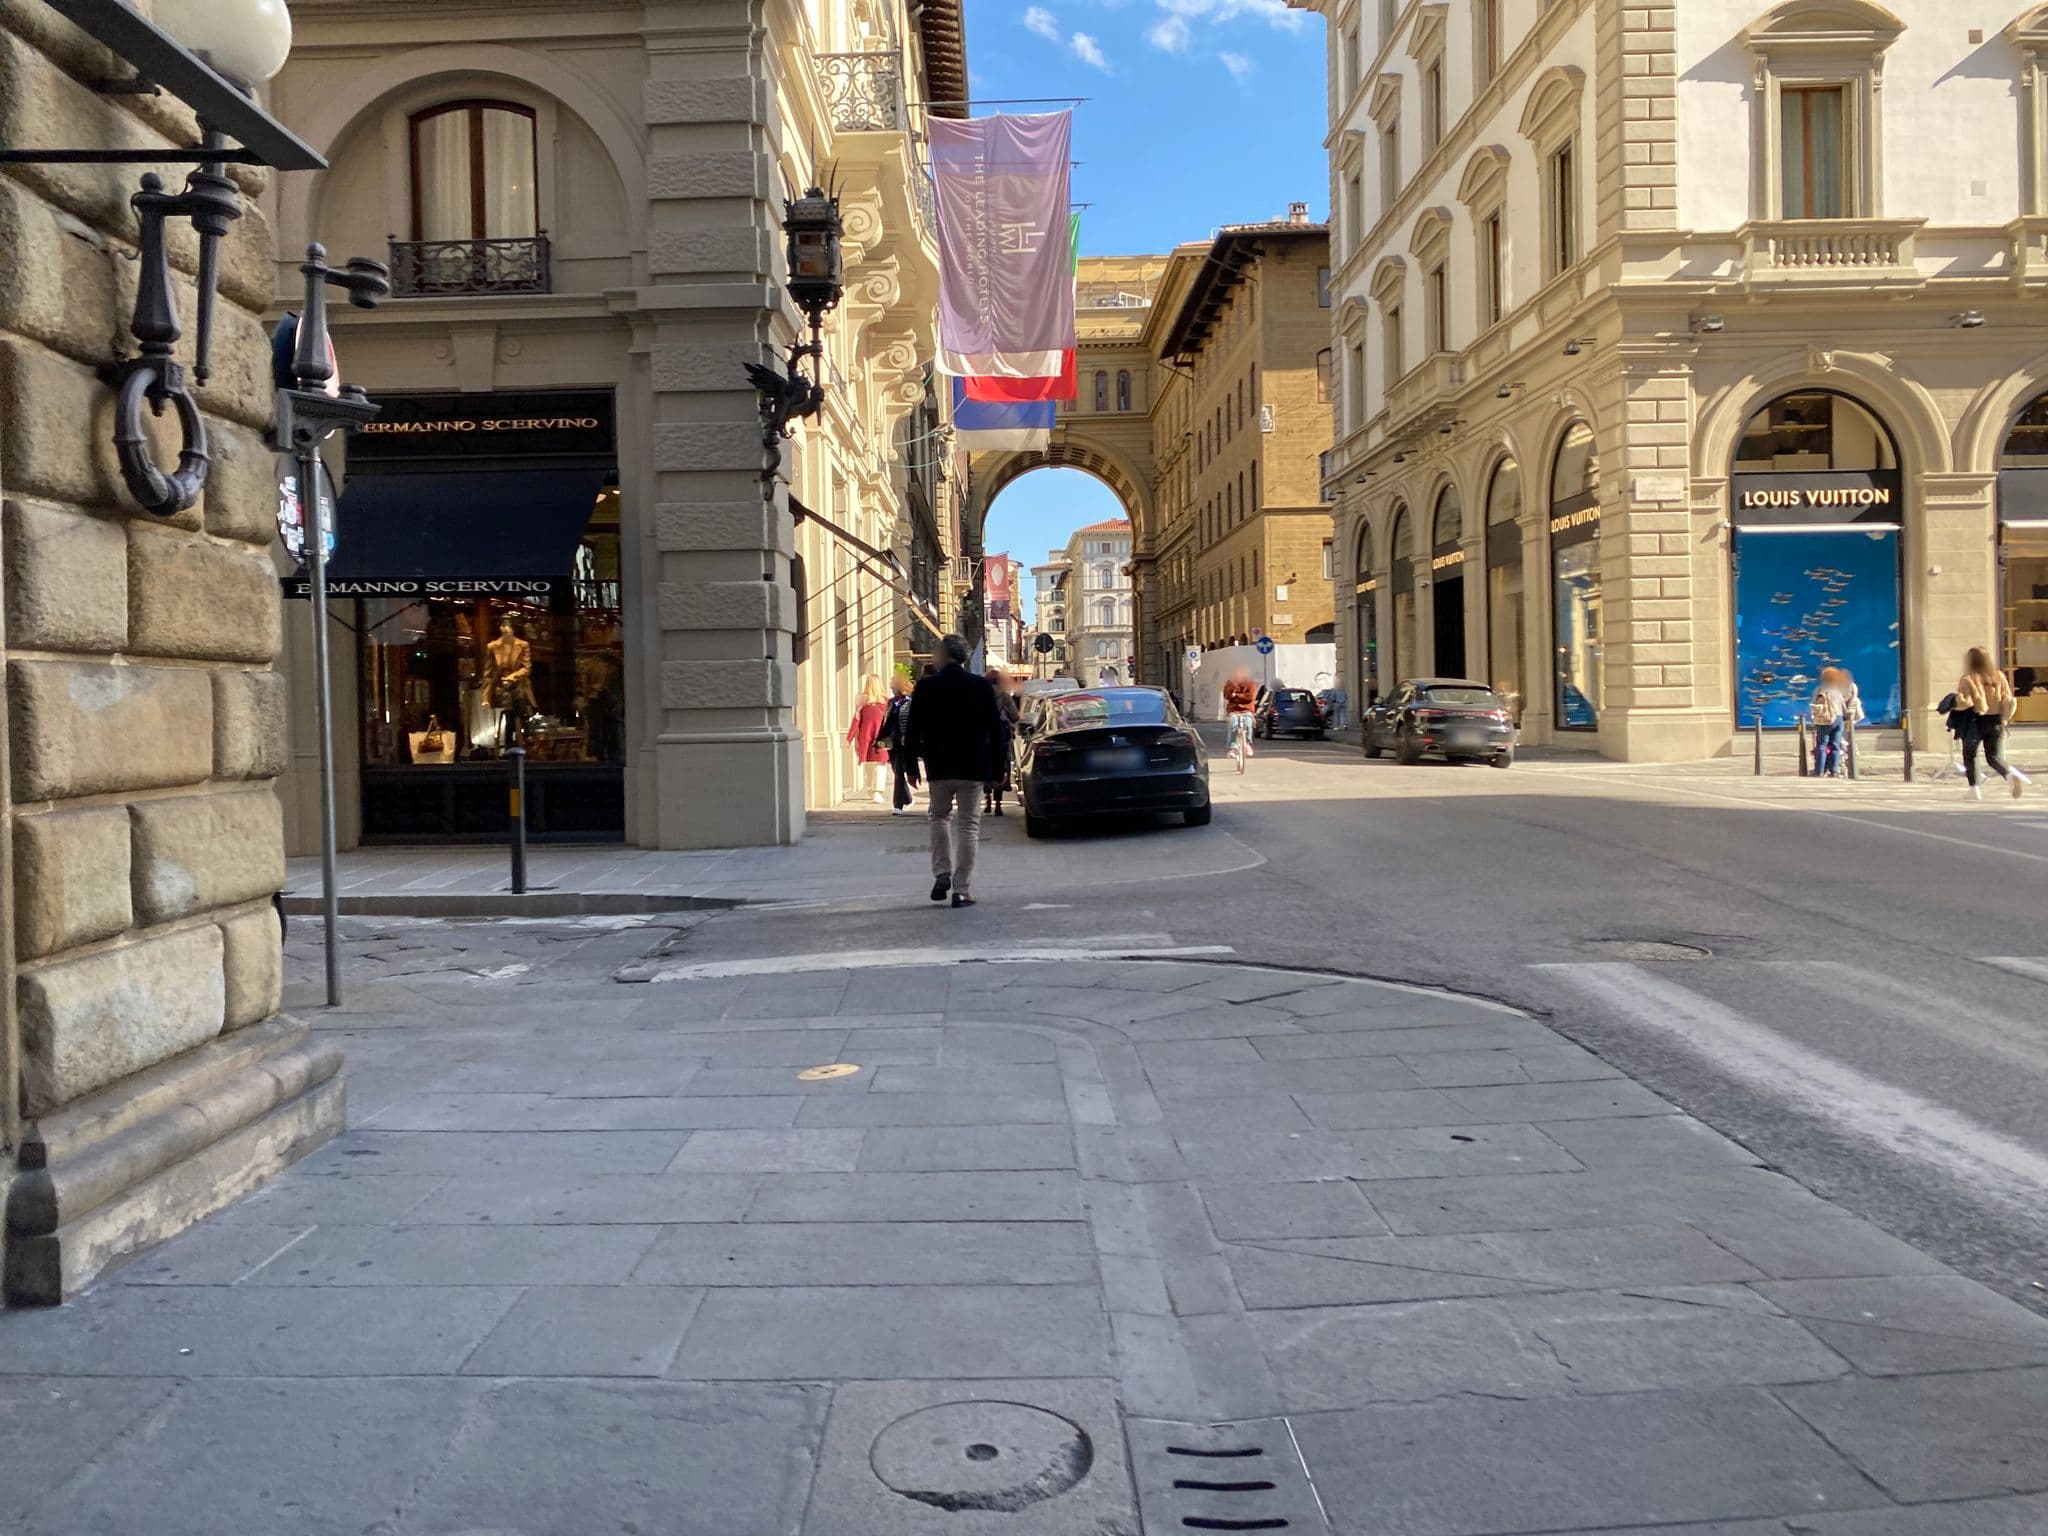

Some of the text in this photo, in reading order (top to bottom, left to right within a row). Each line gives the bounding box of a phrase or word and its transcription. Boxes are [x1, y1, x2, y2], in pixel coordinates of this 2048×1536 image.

[974, 154, 990, 324] THE LEADING HOTELS
[362, 418, 598, 433] ERMANNO SCERVINO
[1744, 488, 1890, 507] LOUIS VUITTON
[1551, 505, 1600, 533] LOUIS VUITTON
[296, 581, 551, 593] EMANNO SCERVINO
